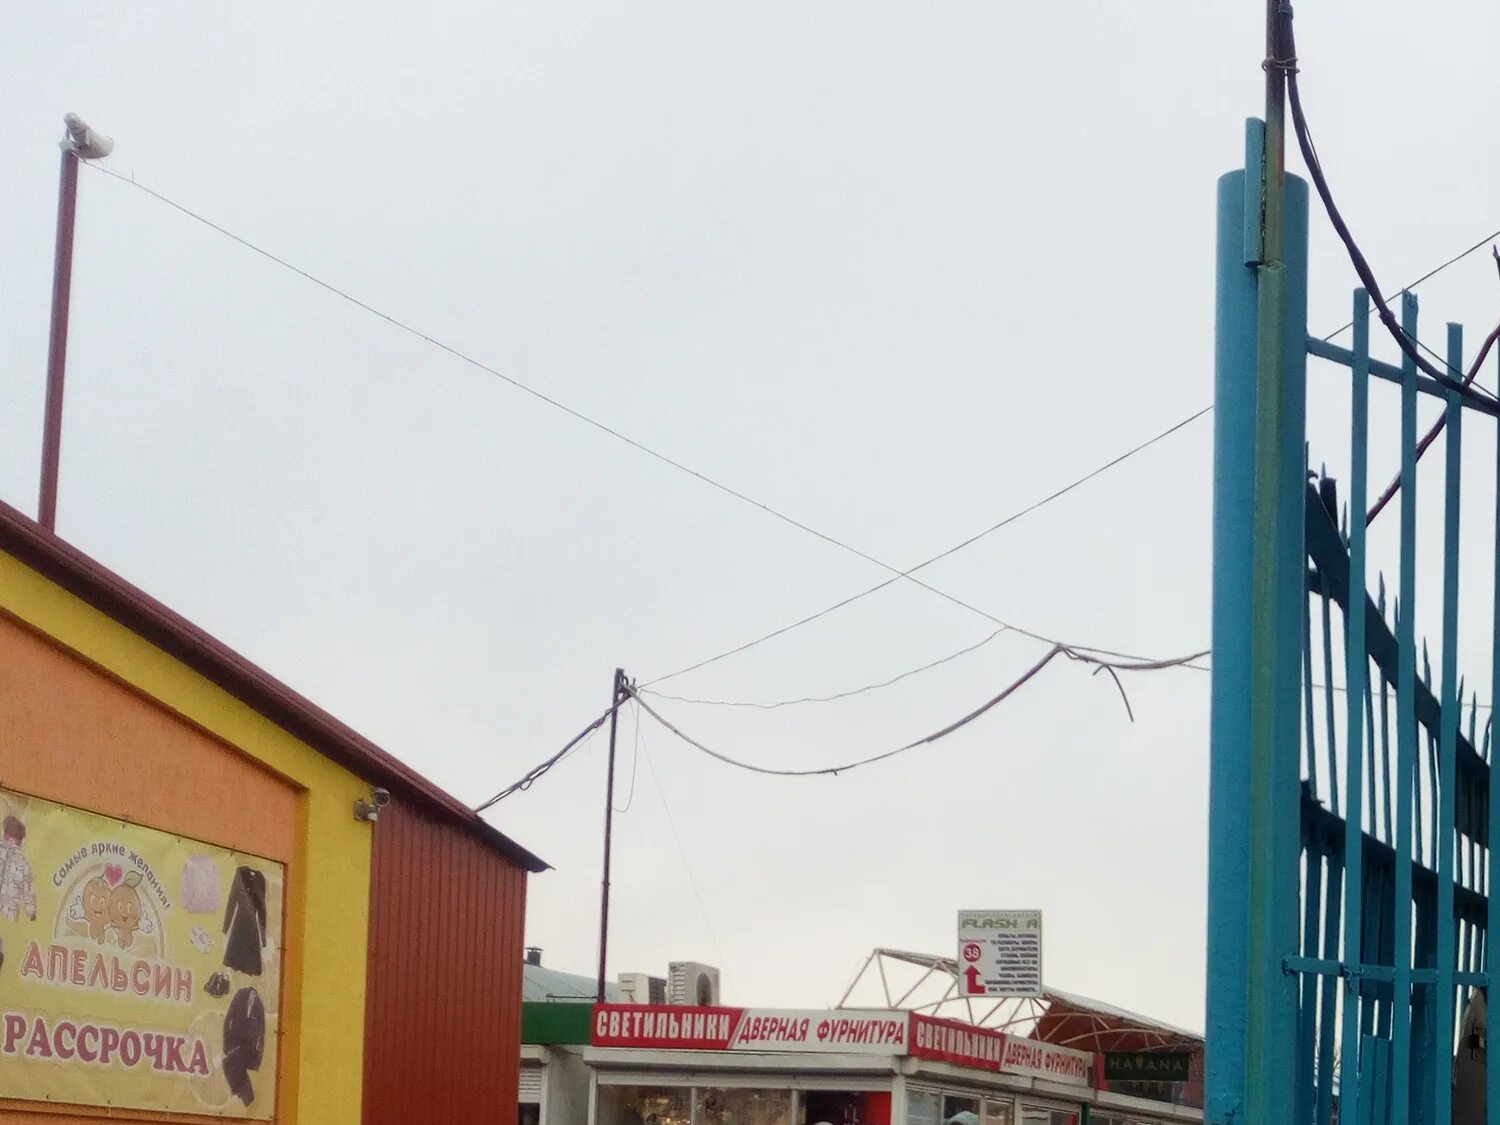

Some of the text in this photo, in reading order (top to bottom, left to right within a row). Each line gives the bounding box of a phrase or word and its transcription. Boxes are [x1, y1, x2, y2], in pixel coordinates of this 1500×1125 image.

[20, 941, 193, 1002] АПЕЛЬСИН
[3, 1014, 211, 1076] РАССРОЧКА
[596, 1010, 904, 1045] СВЕТИЛЬНИКИ ДВЕРНАЯ ФУРНИТУРА
[916, 1021, 1087, 1078] СВЕТИЛЬНИКИ ДВЕРНАЯ ФУРНИТУРА
